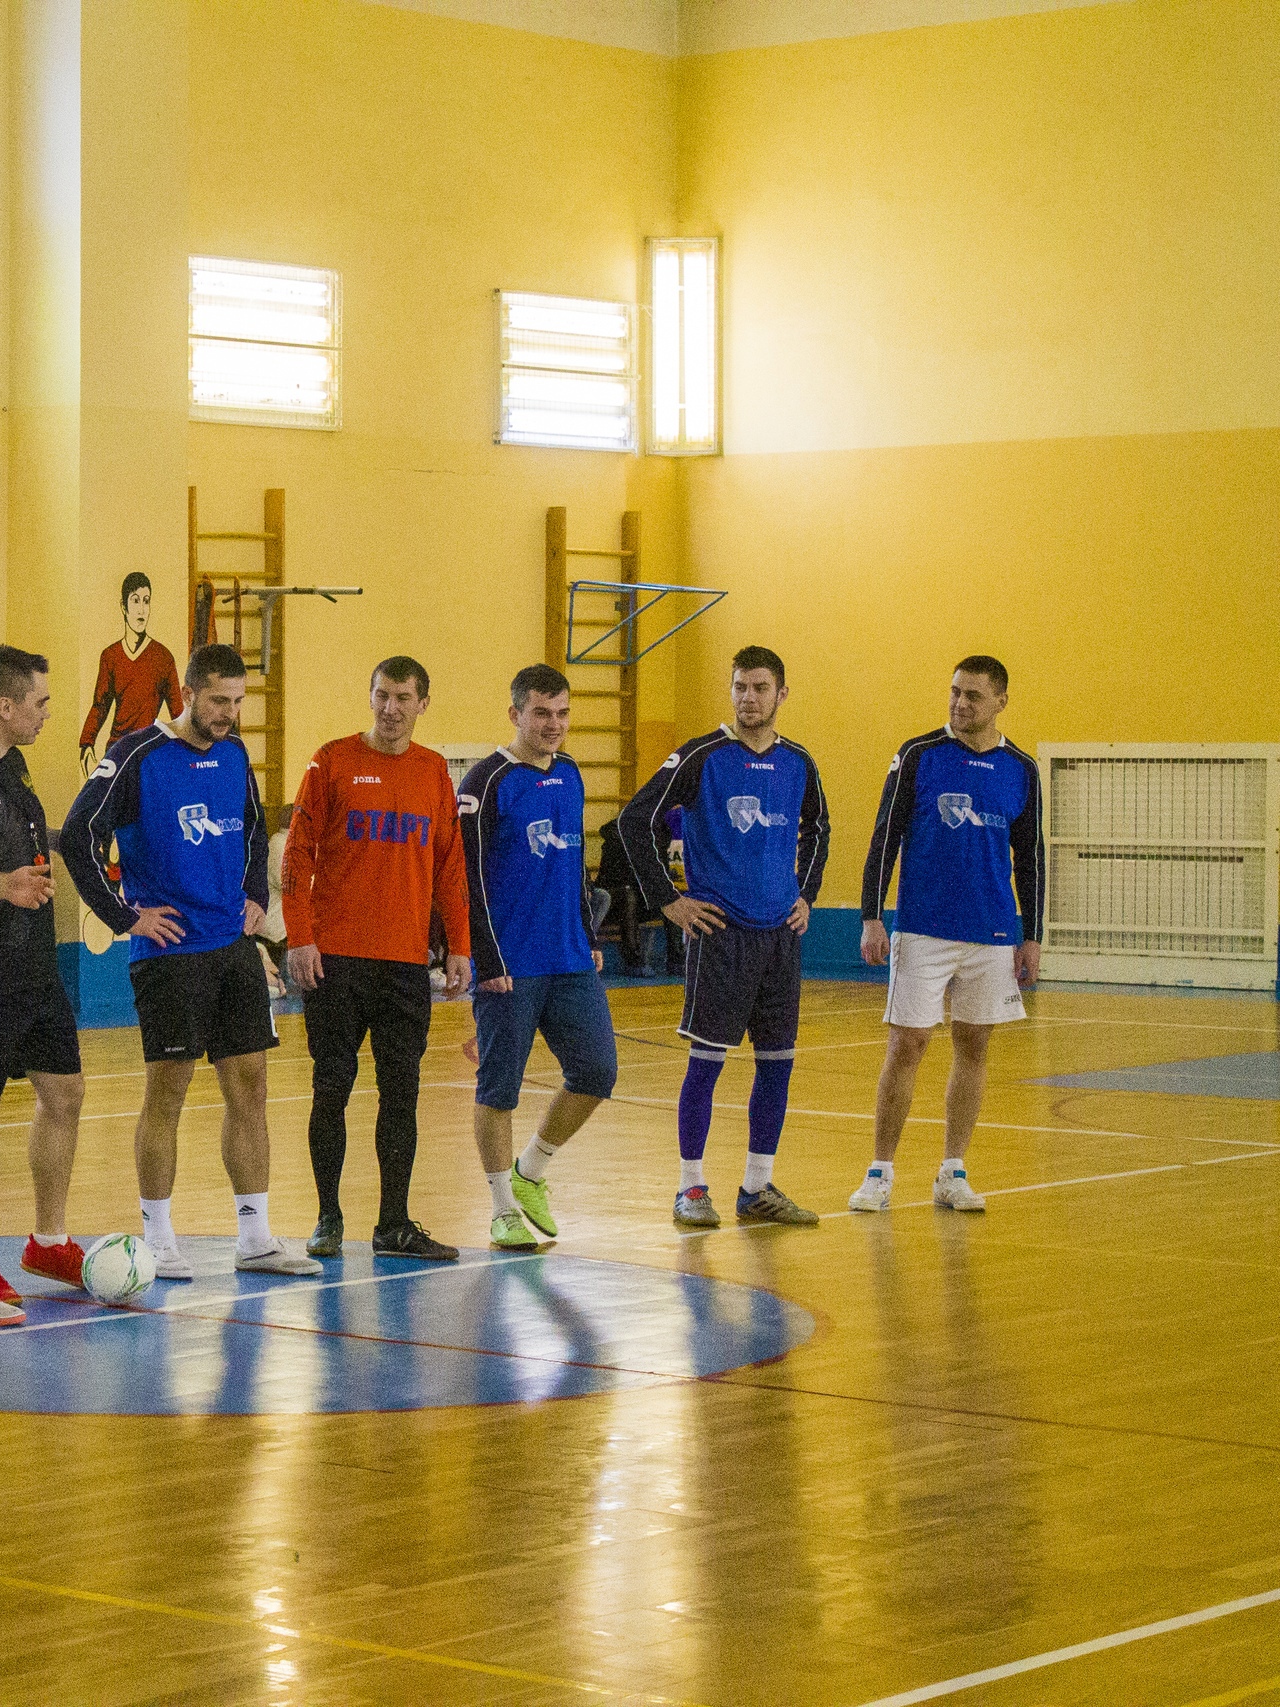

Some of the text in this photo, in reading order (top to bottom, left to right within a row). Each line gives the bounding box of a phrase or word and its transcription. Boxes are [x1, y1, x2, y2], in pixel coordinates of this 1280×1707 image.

[196, 760, 219, 769] PATRICK
[751, 762, 775, 770] PATRICK
[969, 760, 995, 770] PATRICK
[345, 809, 432, 847] СТАРТ
